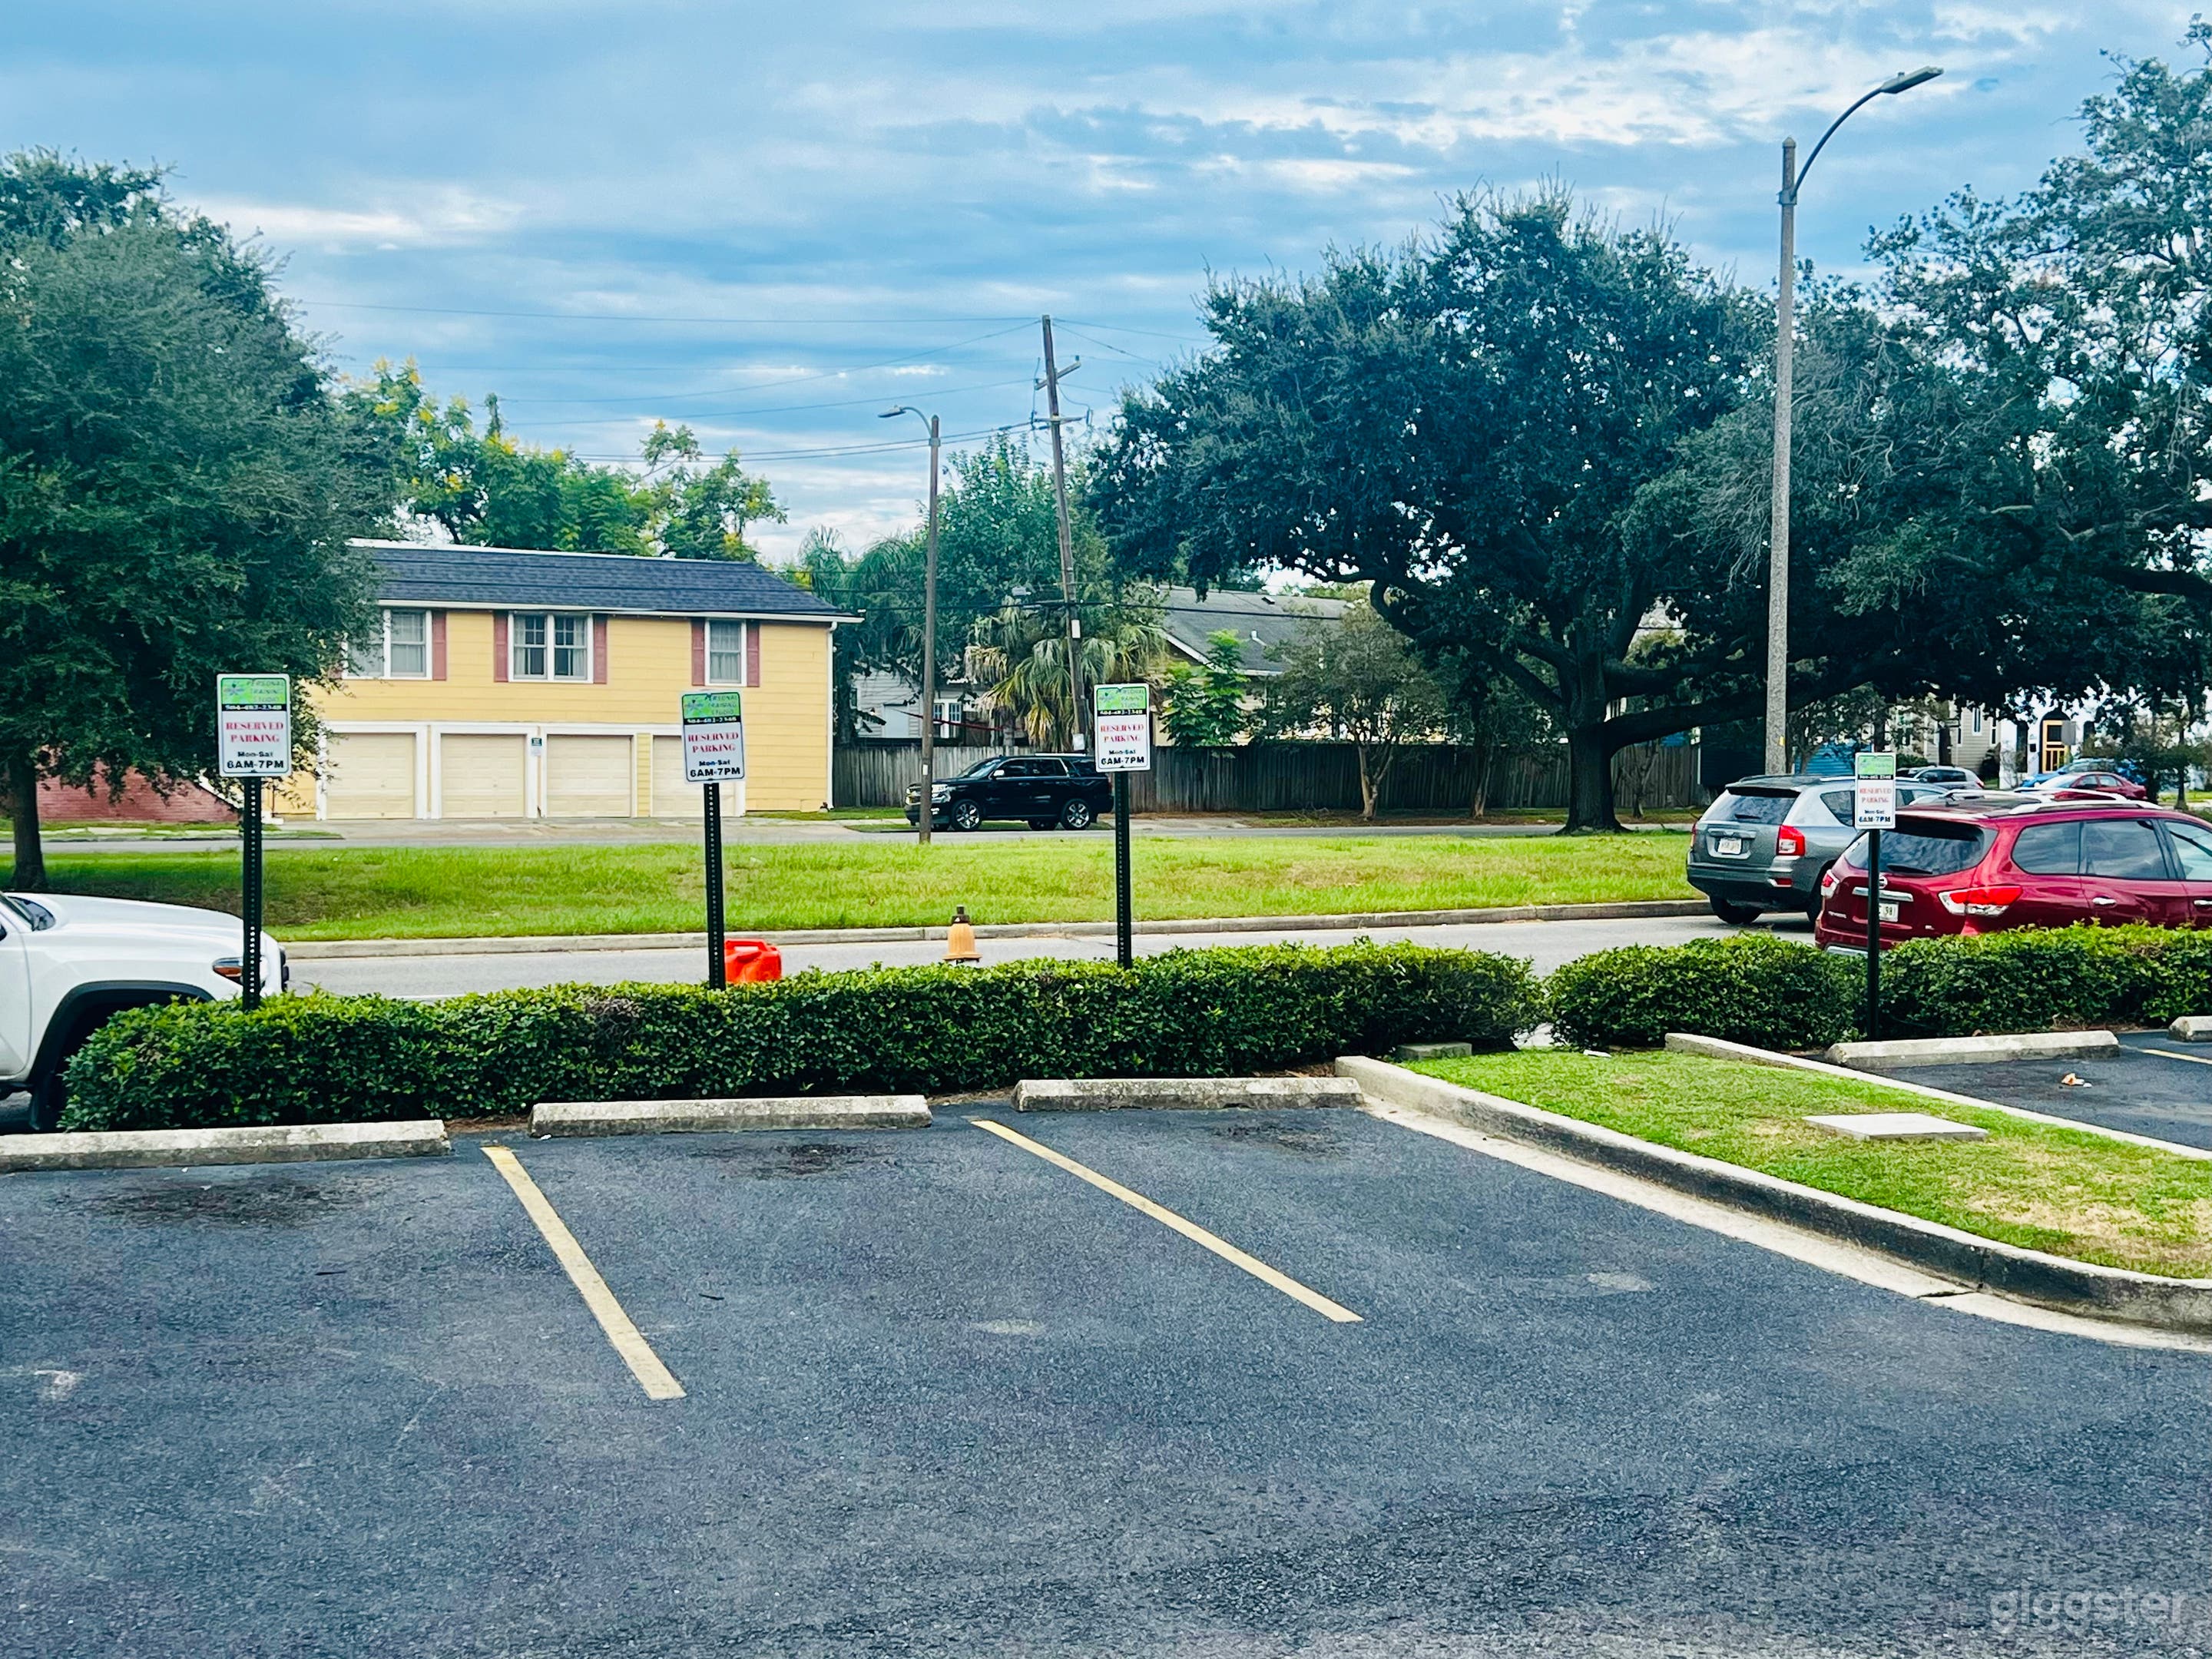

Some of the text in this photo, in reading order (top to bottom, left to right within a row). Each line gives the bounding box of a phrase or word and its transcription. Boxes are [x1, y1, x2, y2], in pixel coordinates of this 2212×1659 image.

[1101, 724, 1144, 733] RESERVED
[230, 734, 280, 743] PARKING
[688, 732, 739, 742] RESERVED
[1104, 734, 1141, 743] PARKING
[693, 743, 736, 753] PARKING
[227, 760, 283, 769] 6AM-7PM
[1101, 757, 1144, 765] 6AM-7PM
[690, 767, 740, 777] 6AM-7PM
